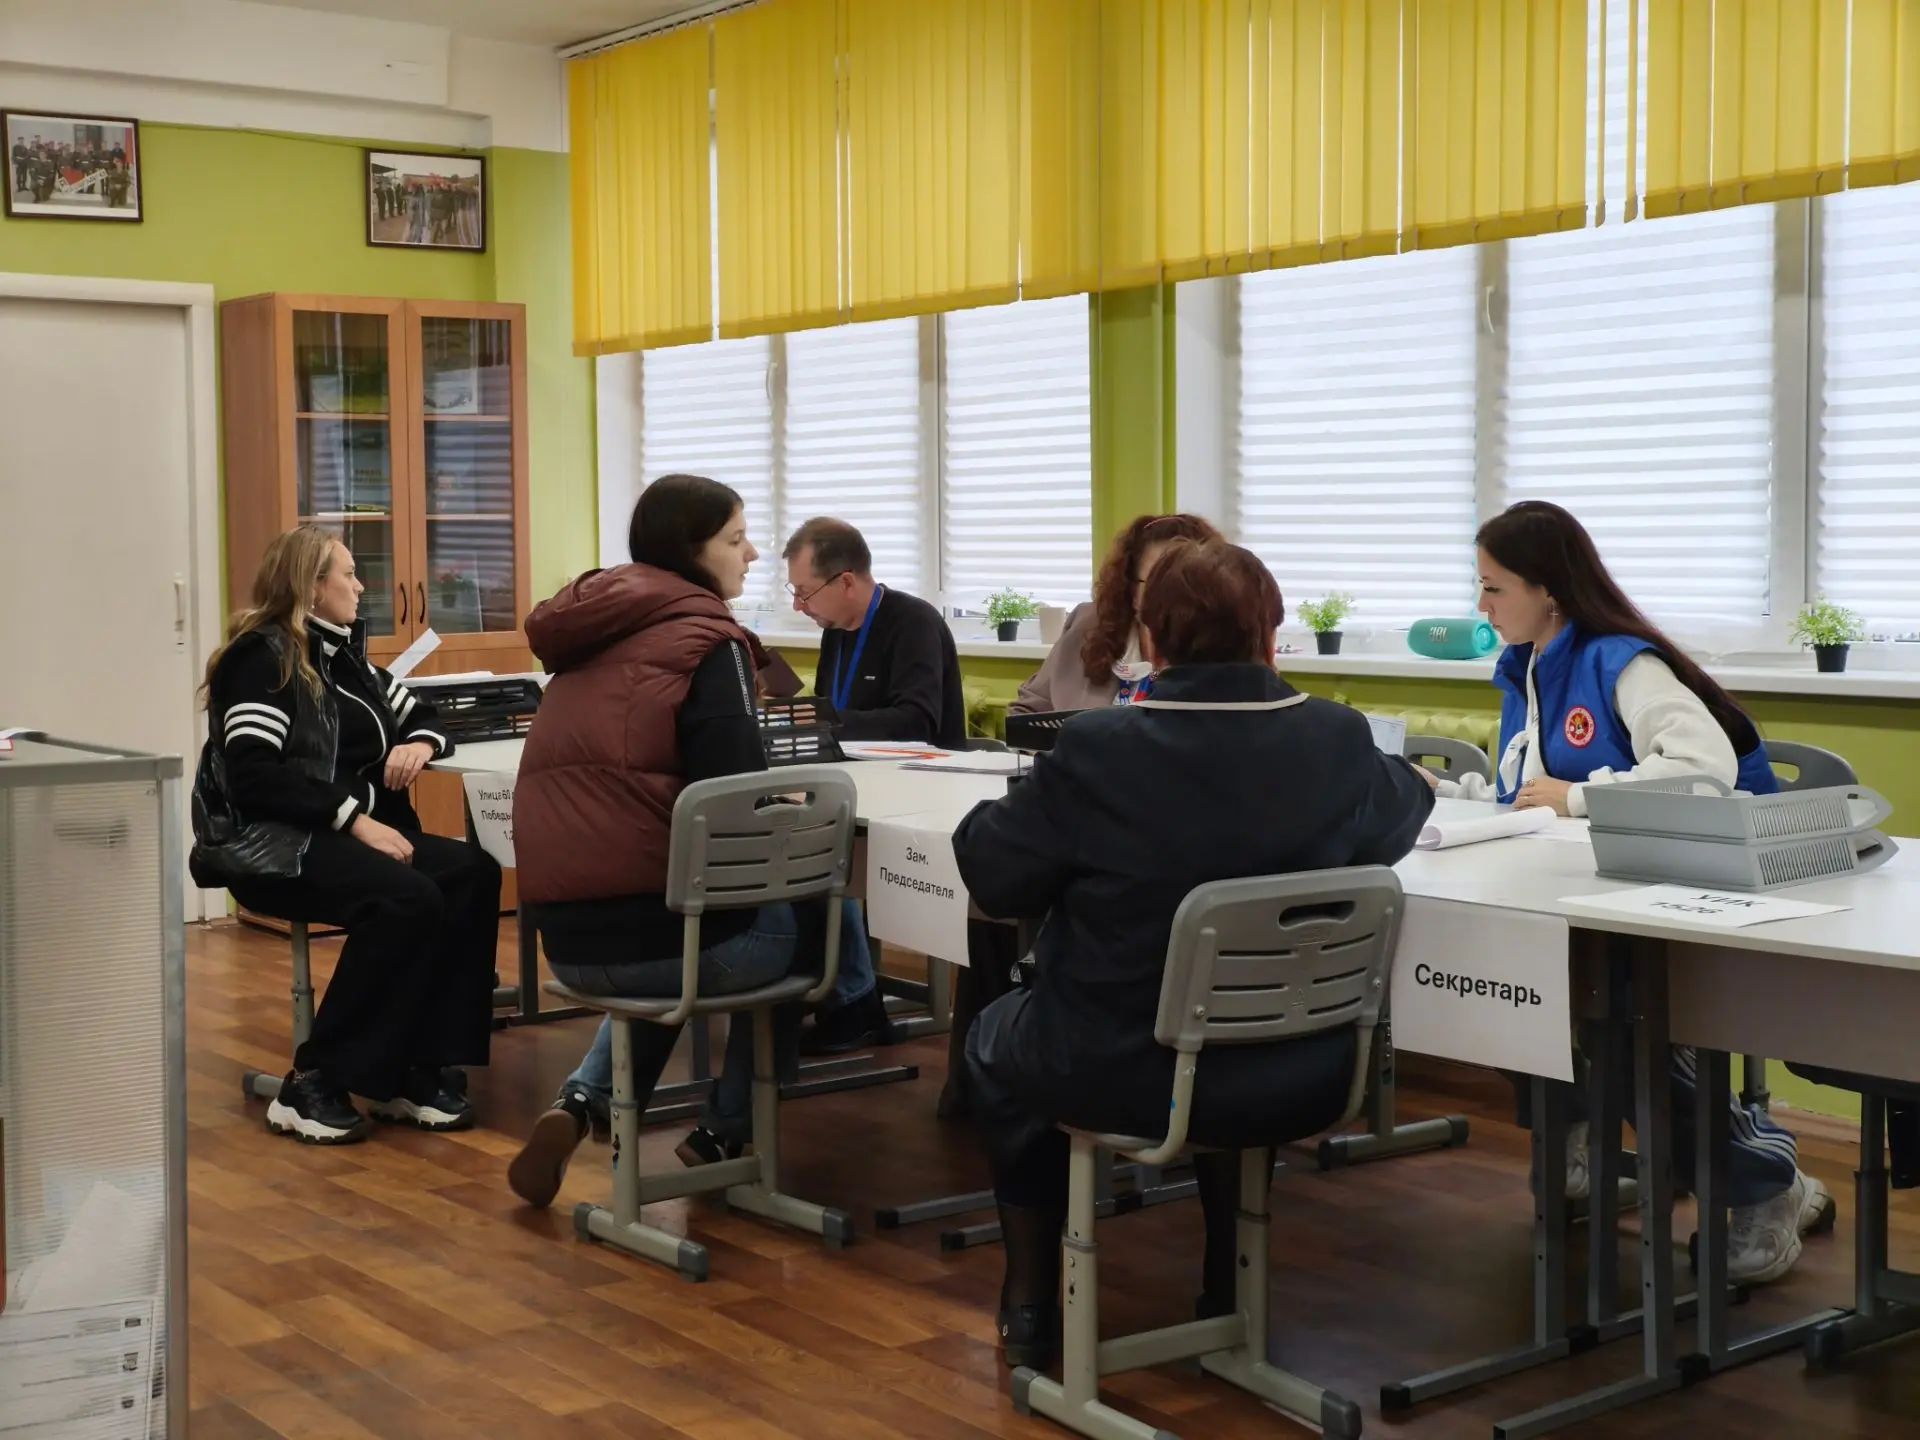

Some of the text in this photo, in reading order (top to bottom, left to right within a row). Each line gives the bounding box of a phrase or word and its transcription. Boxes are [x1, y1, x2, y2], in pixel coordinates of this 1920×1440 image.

[1429, 626, 1448, 642] JBL
[478, 789, 502, 801] Улица
[906, 847, 929, 865] Зам.
[880, 867, 954, 899] Председателя
[1690, 894, 1767, 907] УИК
[1415, 963, 1541, 1007] Секретарь
